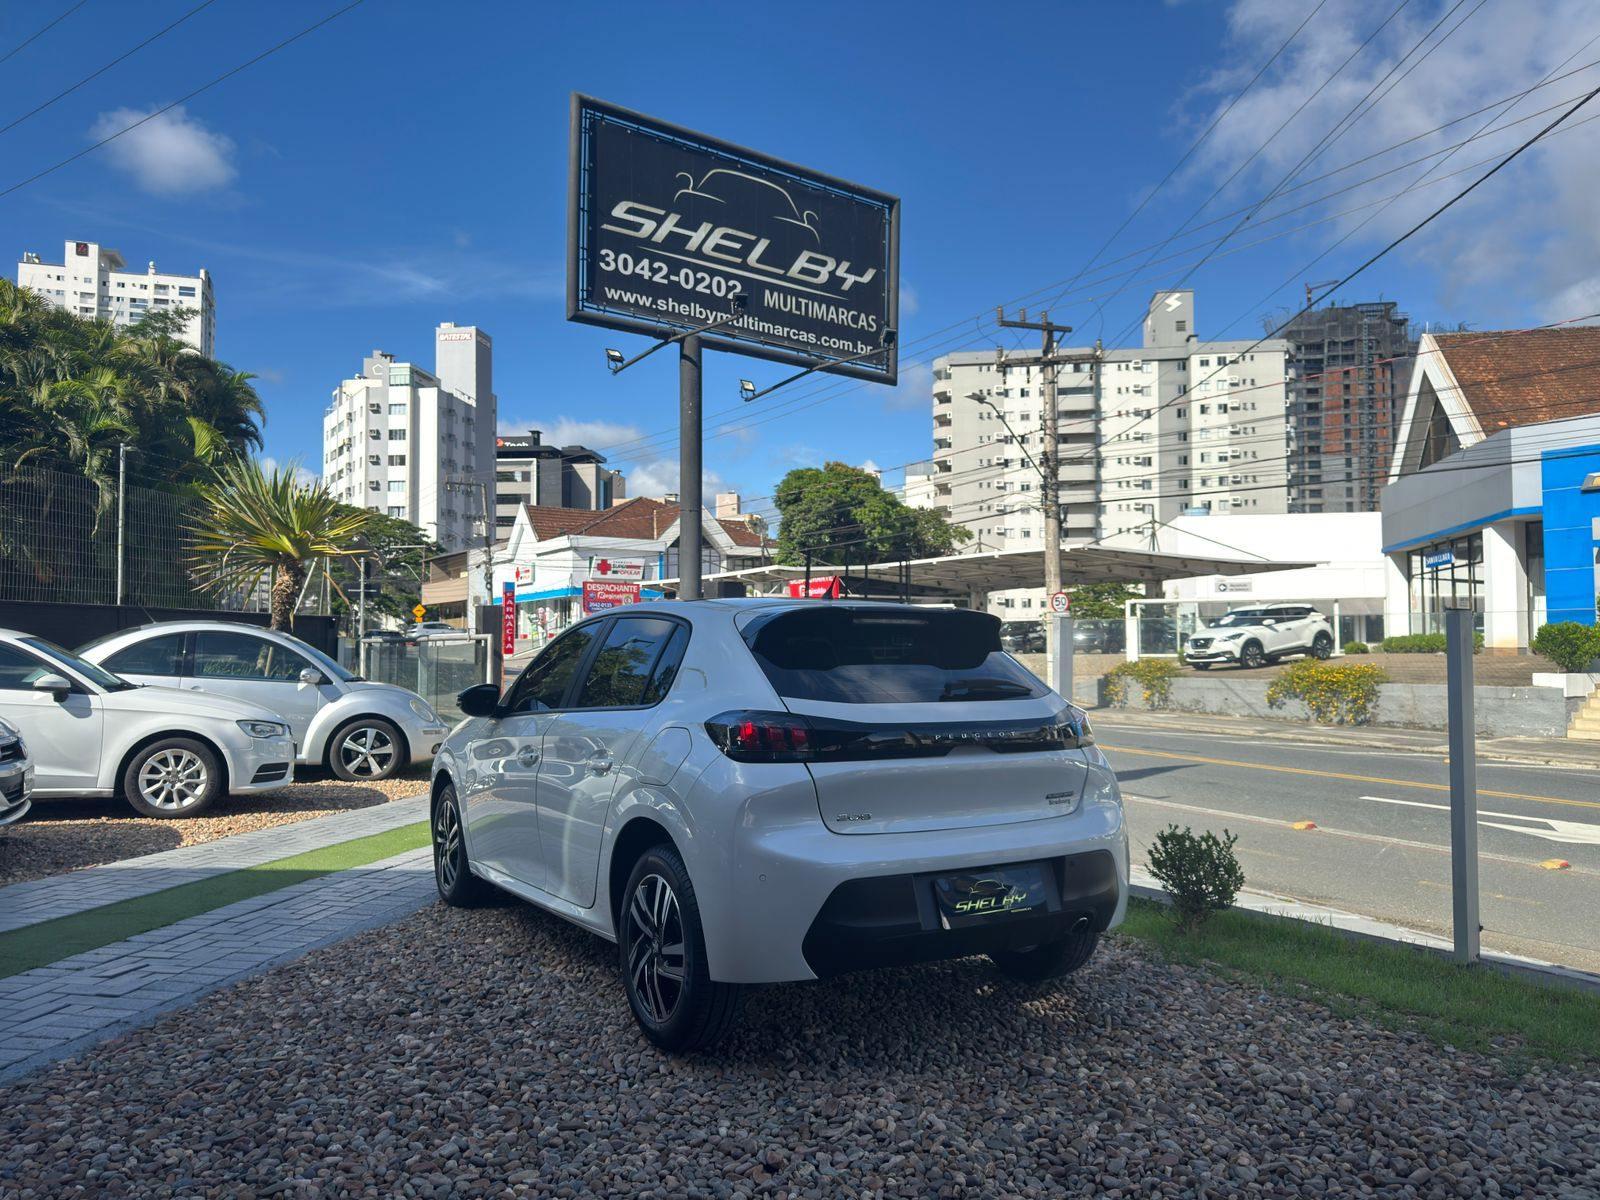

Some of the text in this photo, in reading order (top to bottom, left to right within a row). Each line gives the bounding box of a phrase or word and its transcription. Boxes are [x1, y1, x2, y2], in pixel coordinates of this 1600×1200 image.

[601, 201, 877, 291] SHELBY
[599, 249, 742, 299] 3042-0202
[604, 286, 873, 355] www.shelbymultimarcas.com.br
[764, 289, 877, 332] MULTIMARCAS
[586, 583, 638, 592] DESPACHANTE
[1055, 597, 1066, 607] 50
[935, 731, 1016, 740] PEUGEOT
